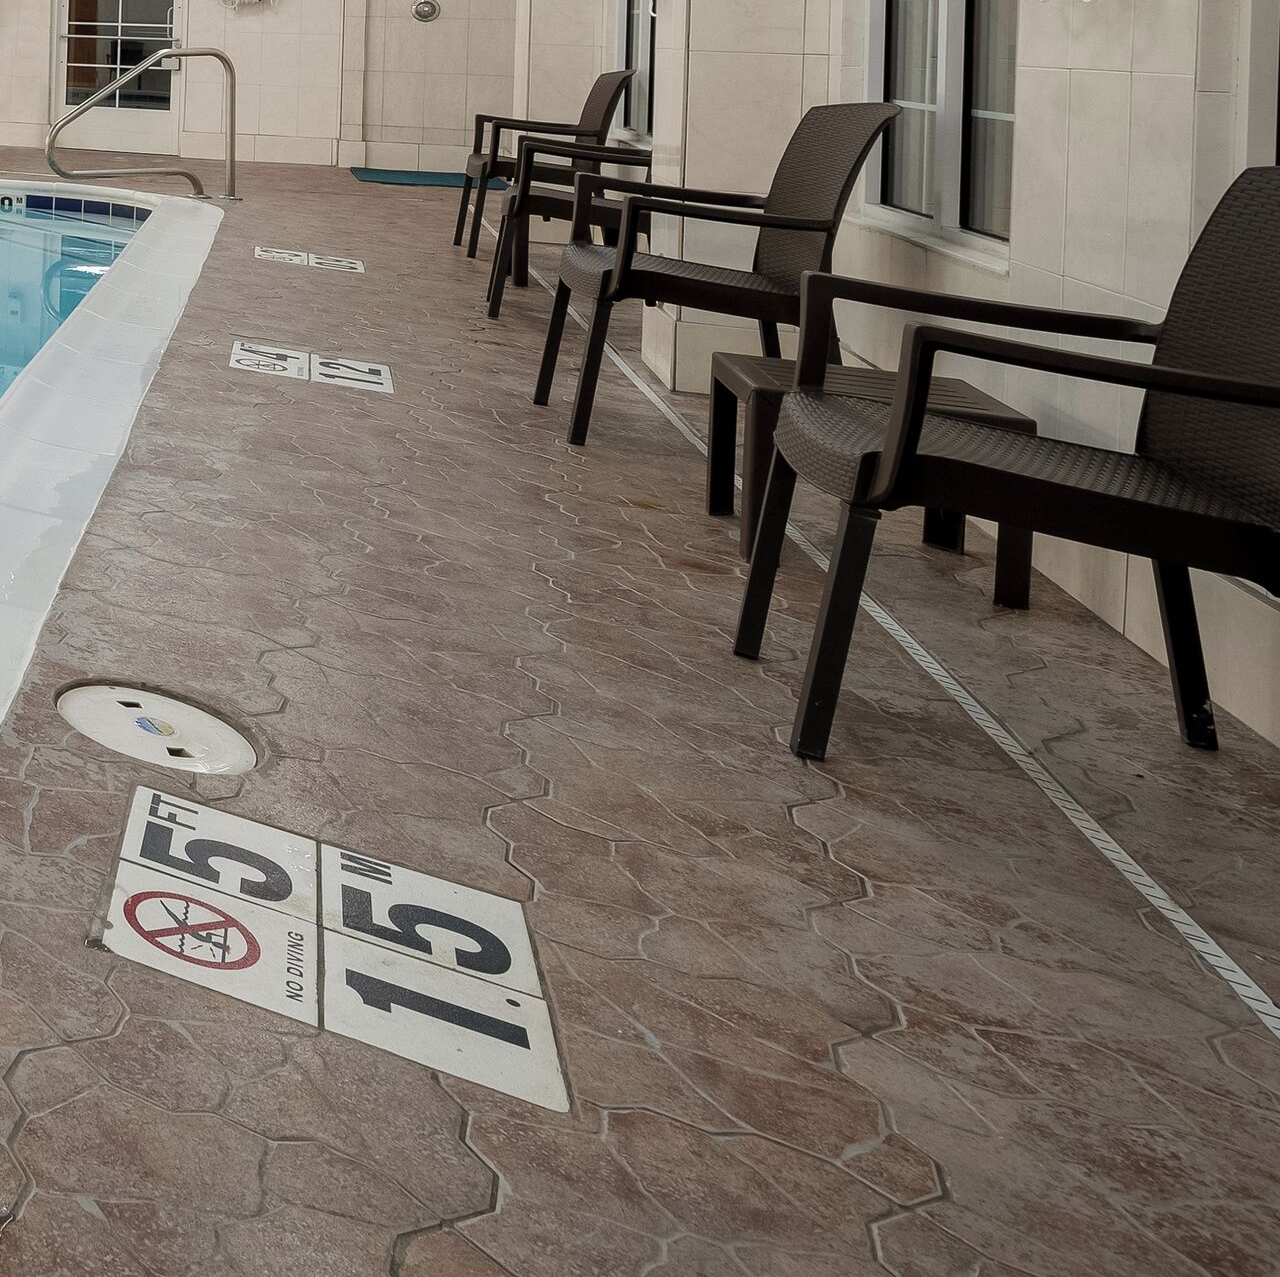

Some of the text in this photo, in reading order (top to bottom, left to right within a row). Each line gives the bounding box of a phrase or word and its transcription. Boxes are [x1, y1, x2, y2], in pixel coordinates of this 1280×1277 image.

[140, 792, 293, 902] 5 FT
[340, 851, 393, 886] M
[285, 931, 305, 1003] NO DIVING
